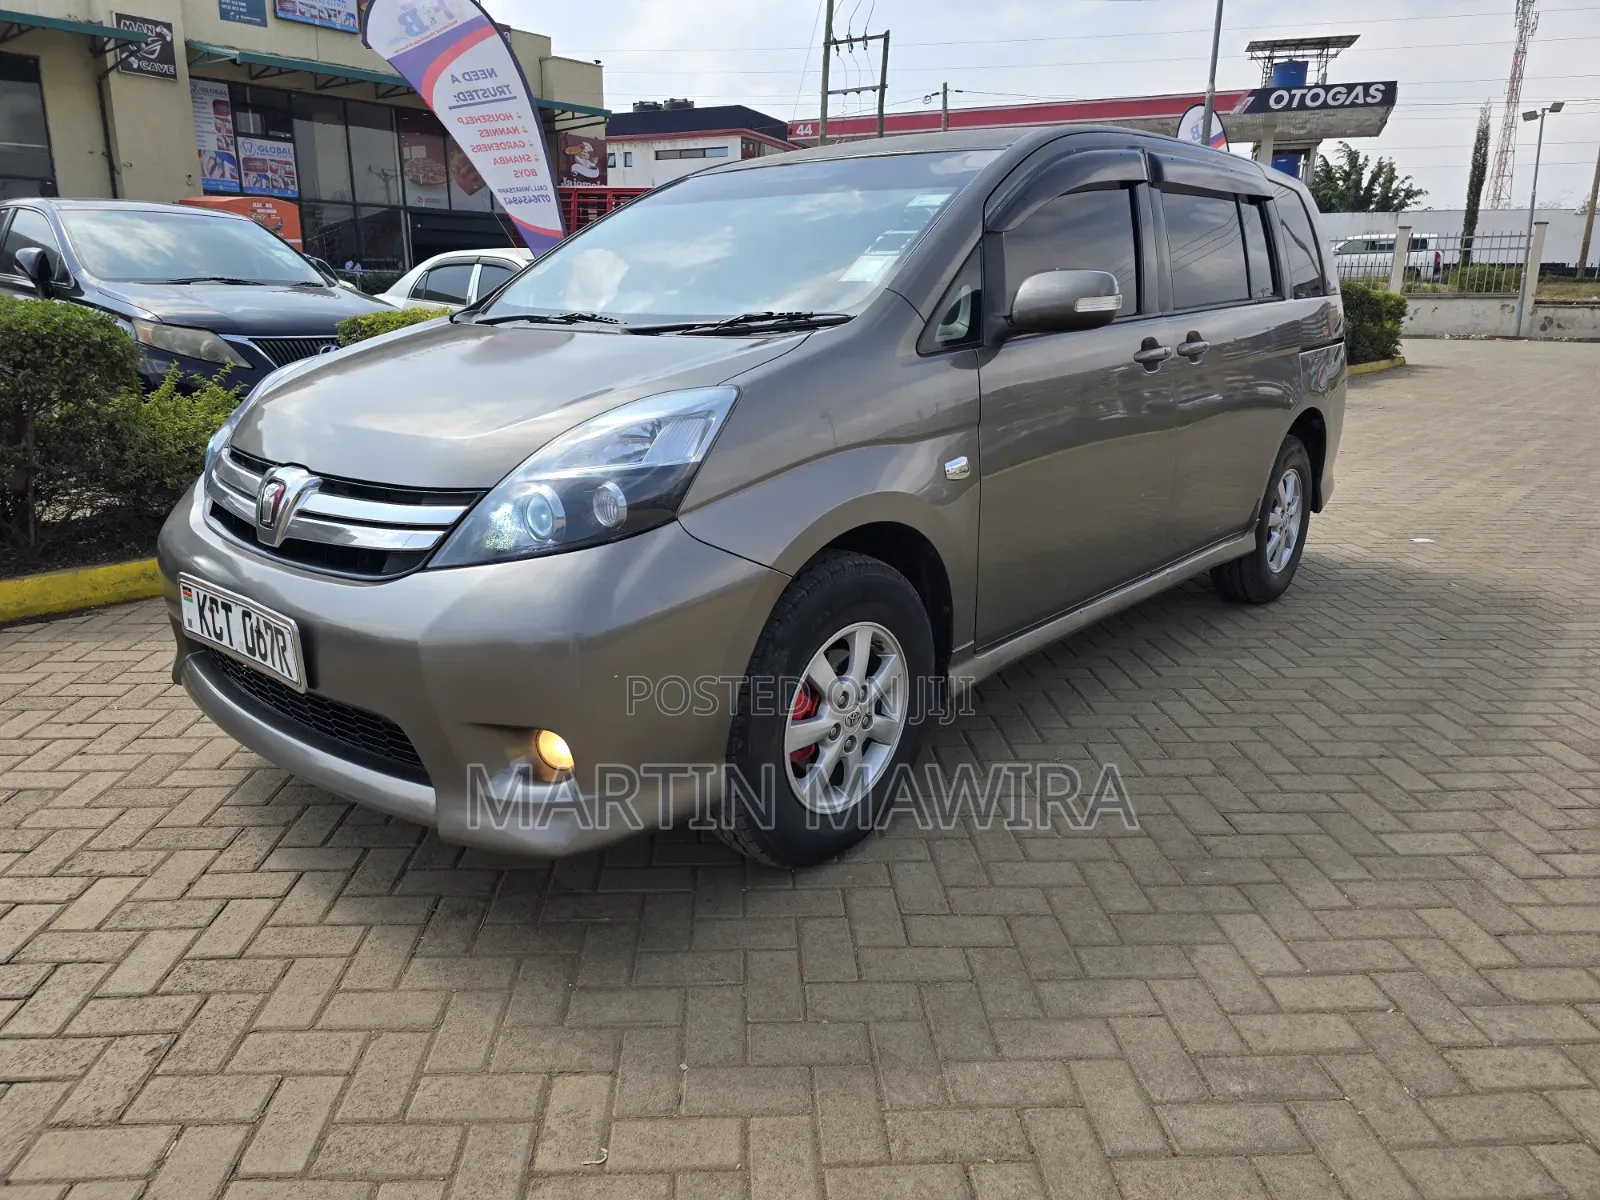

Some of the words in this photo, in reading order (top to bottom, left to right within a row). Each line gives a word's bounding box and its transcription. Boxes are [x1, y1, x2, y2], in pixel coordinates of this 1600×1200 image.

[120, 20, 156, 36] MAN
[139, 60, 175, 75] CAVE
[200, 86, 228, 97] GLOBAL
[1268, 83, 1386, 110] OTOGAS
[796, 123, 813, 137] 44
[257, 144, 292, 155] GLOBAL
[197, 591, 234, 647] KCT
[242, 609, 293, 678] 067R
